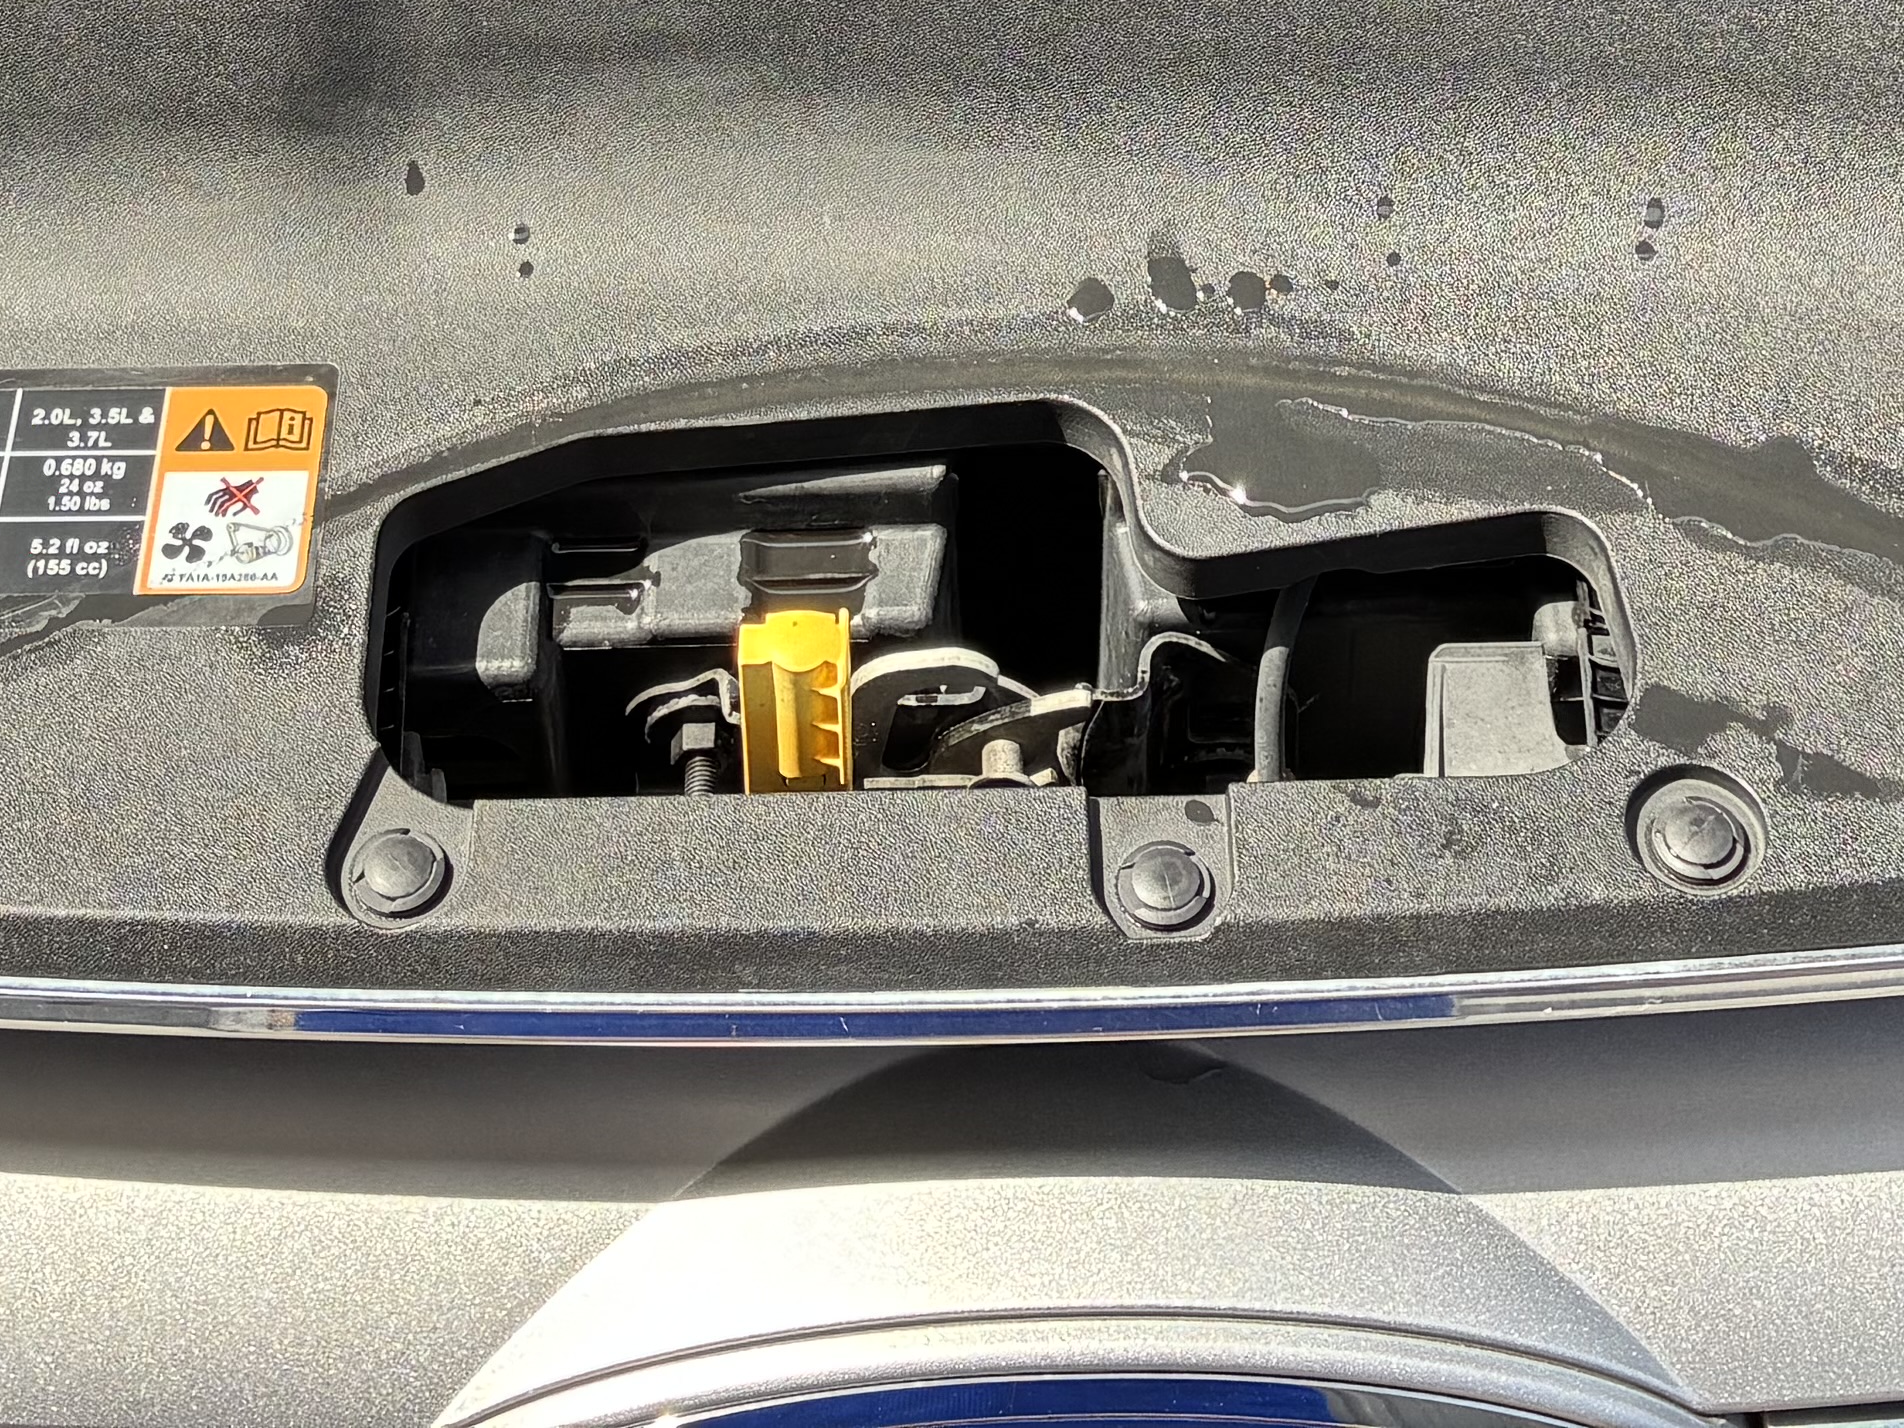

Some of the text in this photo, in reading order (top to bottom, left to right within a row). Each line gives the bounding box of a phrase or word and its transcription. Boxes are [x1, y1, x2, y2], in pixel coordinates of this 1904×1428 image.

[31, 407, 155, 427] 2.0L, 3.5L &
[67, 431, 112, 448] 3.7L
[42, 458, 126, 479] 0.680 kg
[58, 479, 104, 493] 24 oz
[47, 496, 110, 511] 1.50 lbs
[30, 538, 109, 555] 5.2 fl oz
[26, 559, 108, 579] (155 cc)
